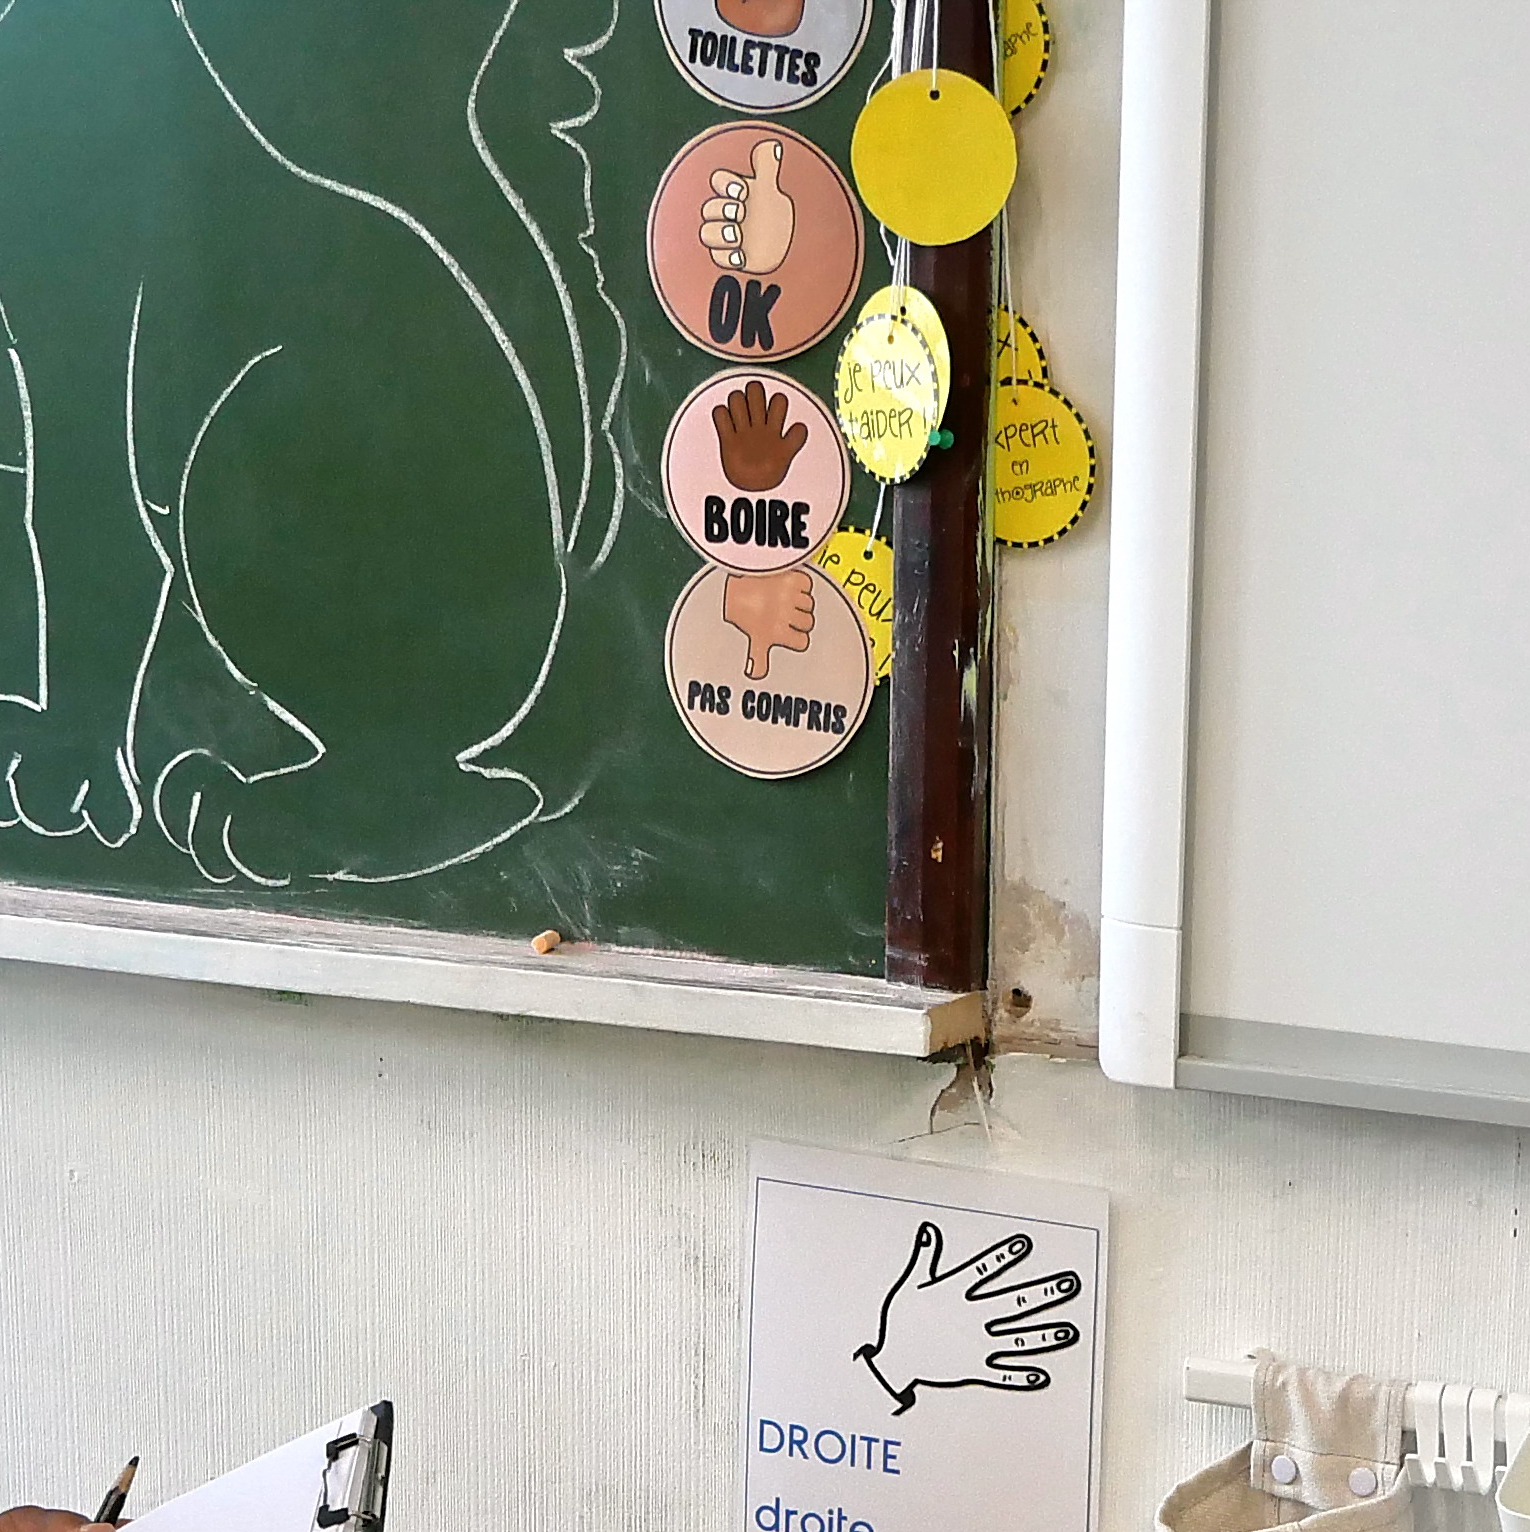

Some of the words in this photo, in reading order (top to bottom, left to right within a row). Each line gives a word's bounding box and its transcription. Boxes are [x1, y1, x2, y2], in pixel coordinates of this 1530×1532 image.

[687, 27, 821, 88] TOILETTES
[708, 275, 781, 351] OK
[844, 362, 863, 404] je
[704, 496, 810, 549] BOIRE
[843, 568, 892, 622] peu
[687, 680, 732, 716] PAS
[741, 689, 848, 735] COMPRIS
[758, 1419, 902, 1476] DROITE
